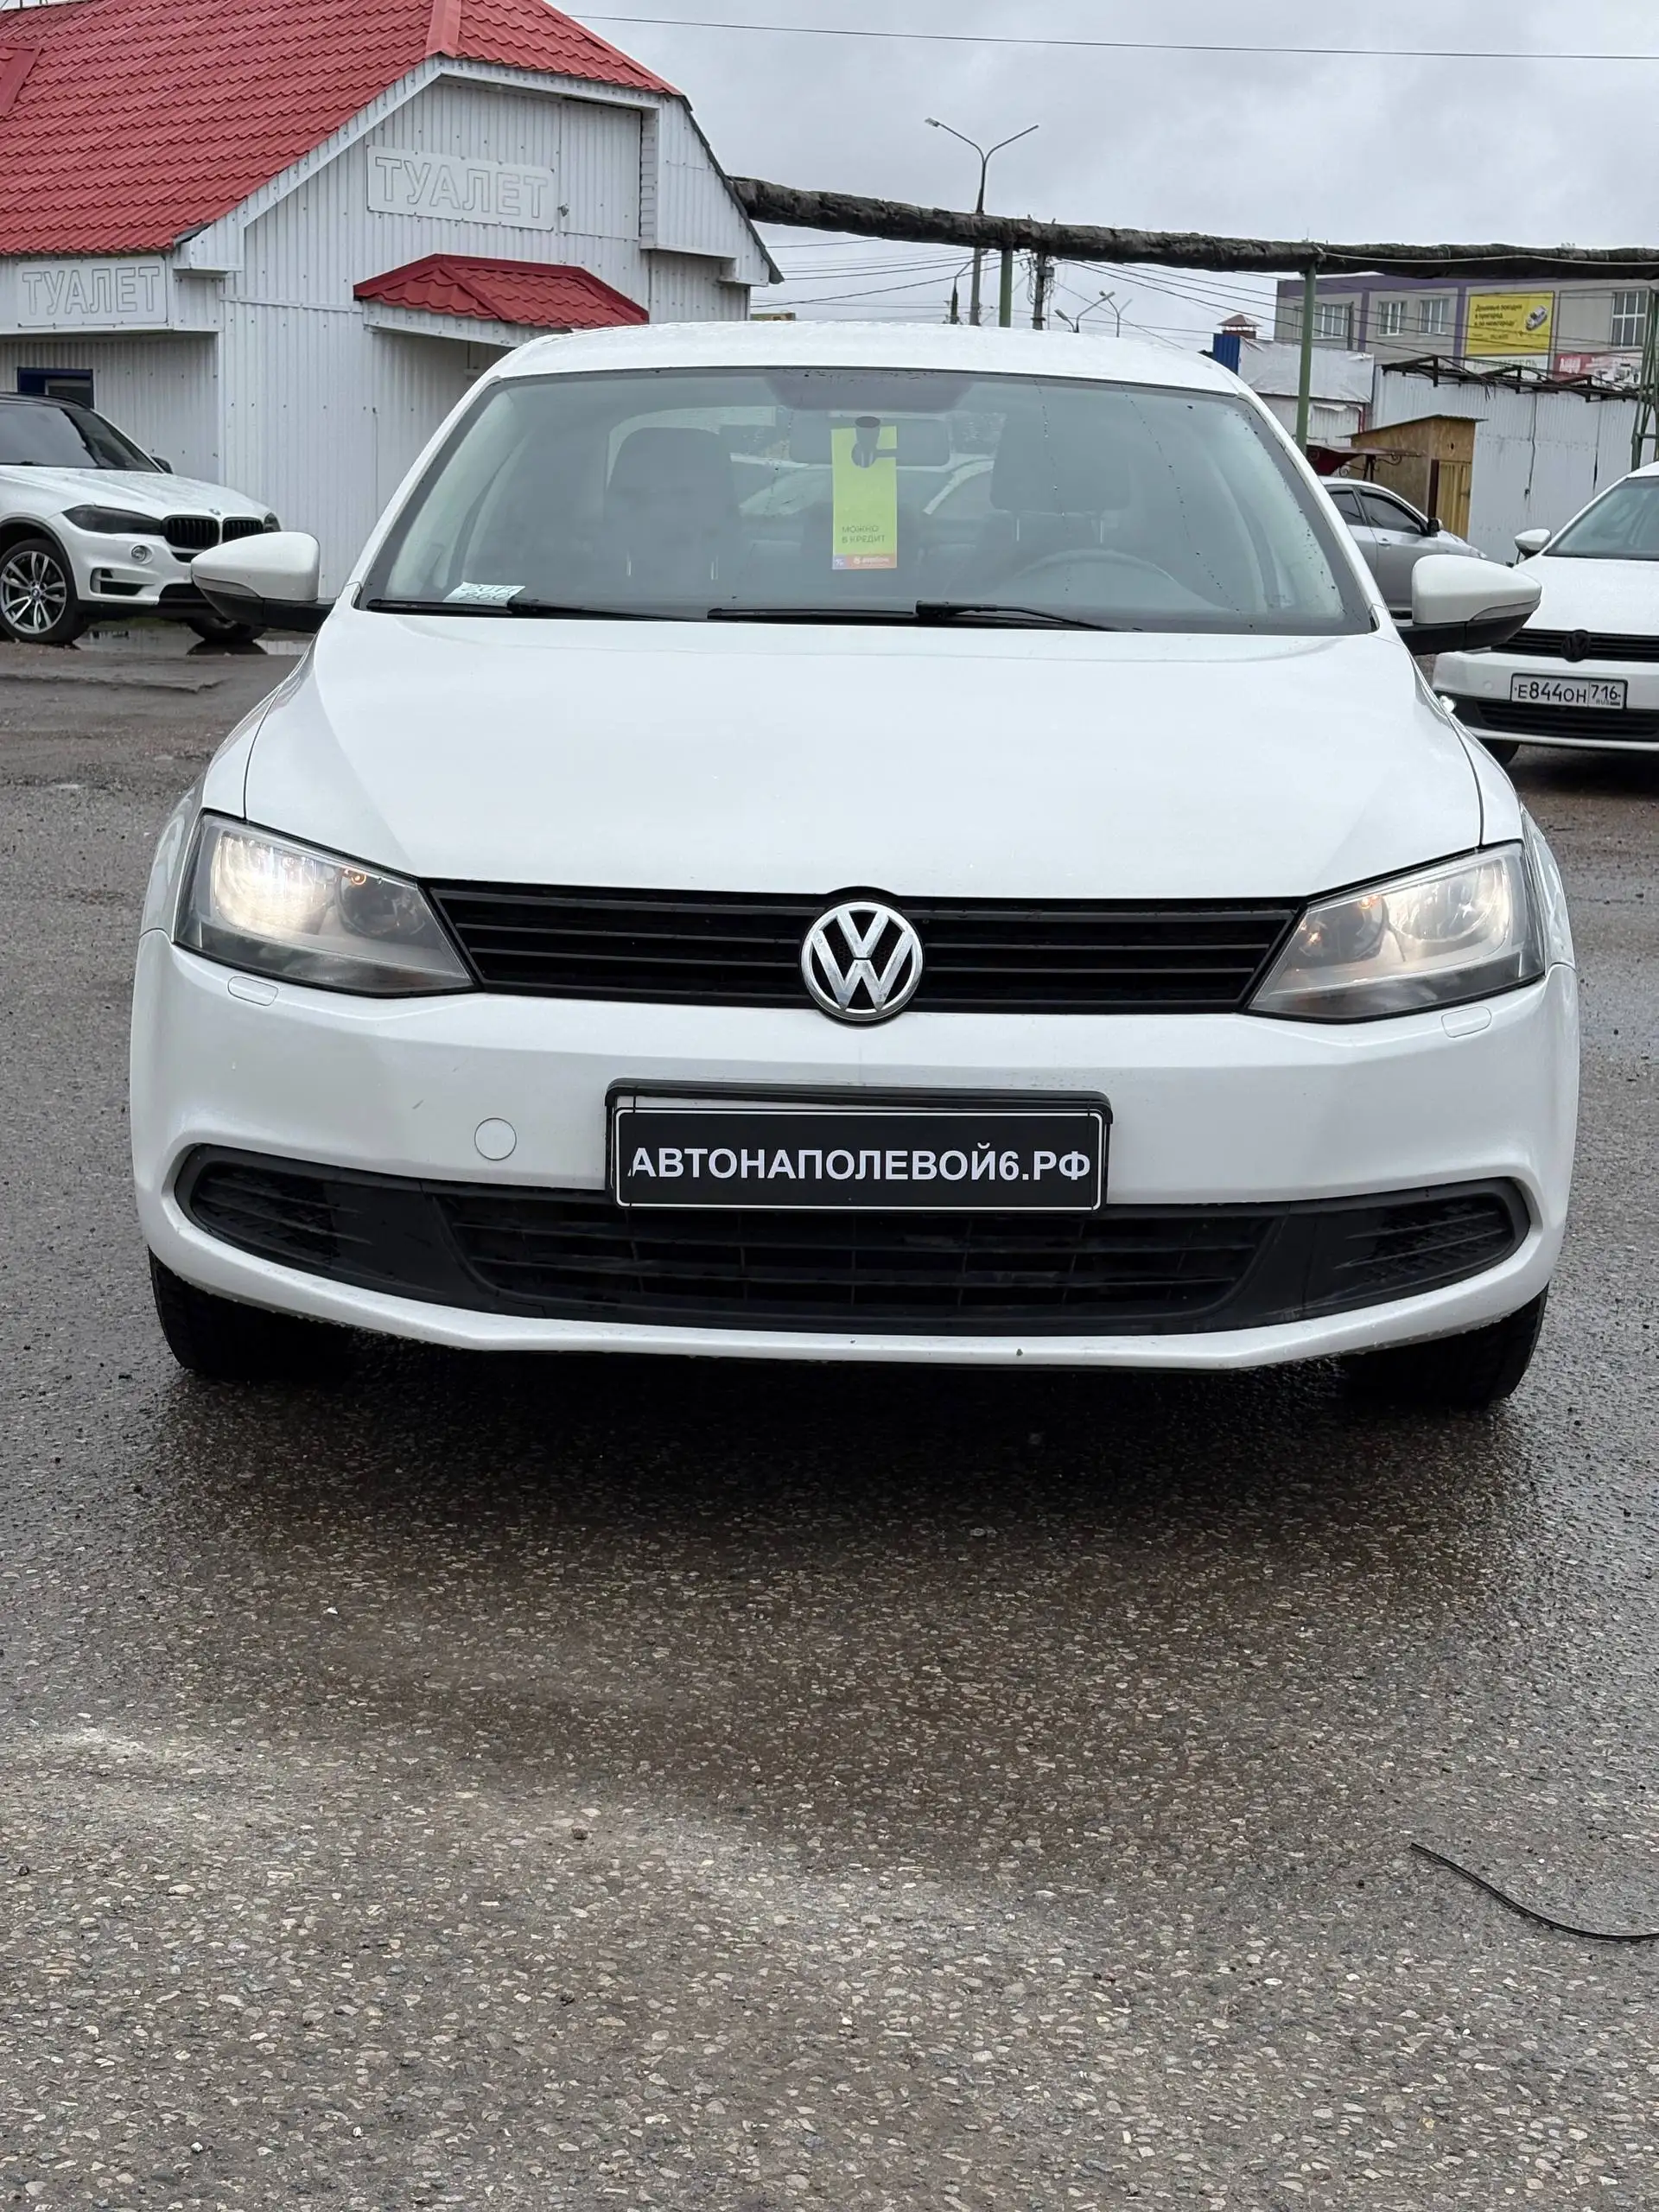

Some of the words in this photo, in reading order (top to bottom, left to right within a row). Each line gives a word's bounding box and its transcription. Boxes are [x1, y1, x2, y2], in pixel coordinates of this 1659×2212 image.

[375, 156, 548, 219] ТУАЛЕТ
[22, 266, 161, 316] ТУАЛЕТ
[842, 524, 880, 533] МОЖНО
[1591, 684, 1618, 701] 716
[805, 904, 919, 1016] VW
[628, 1141, 1091, 1181] АВТОНАПОЛЕВОЙ6.РФ
